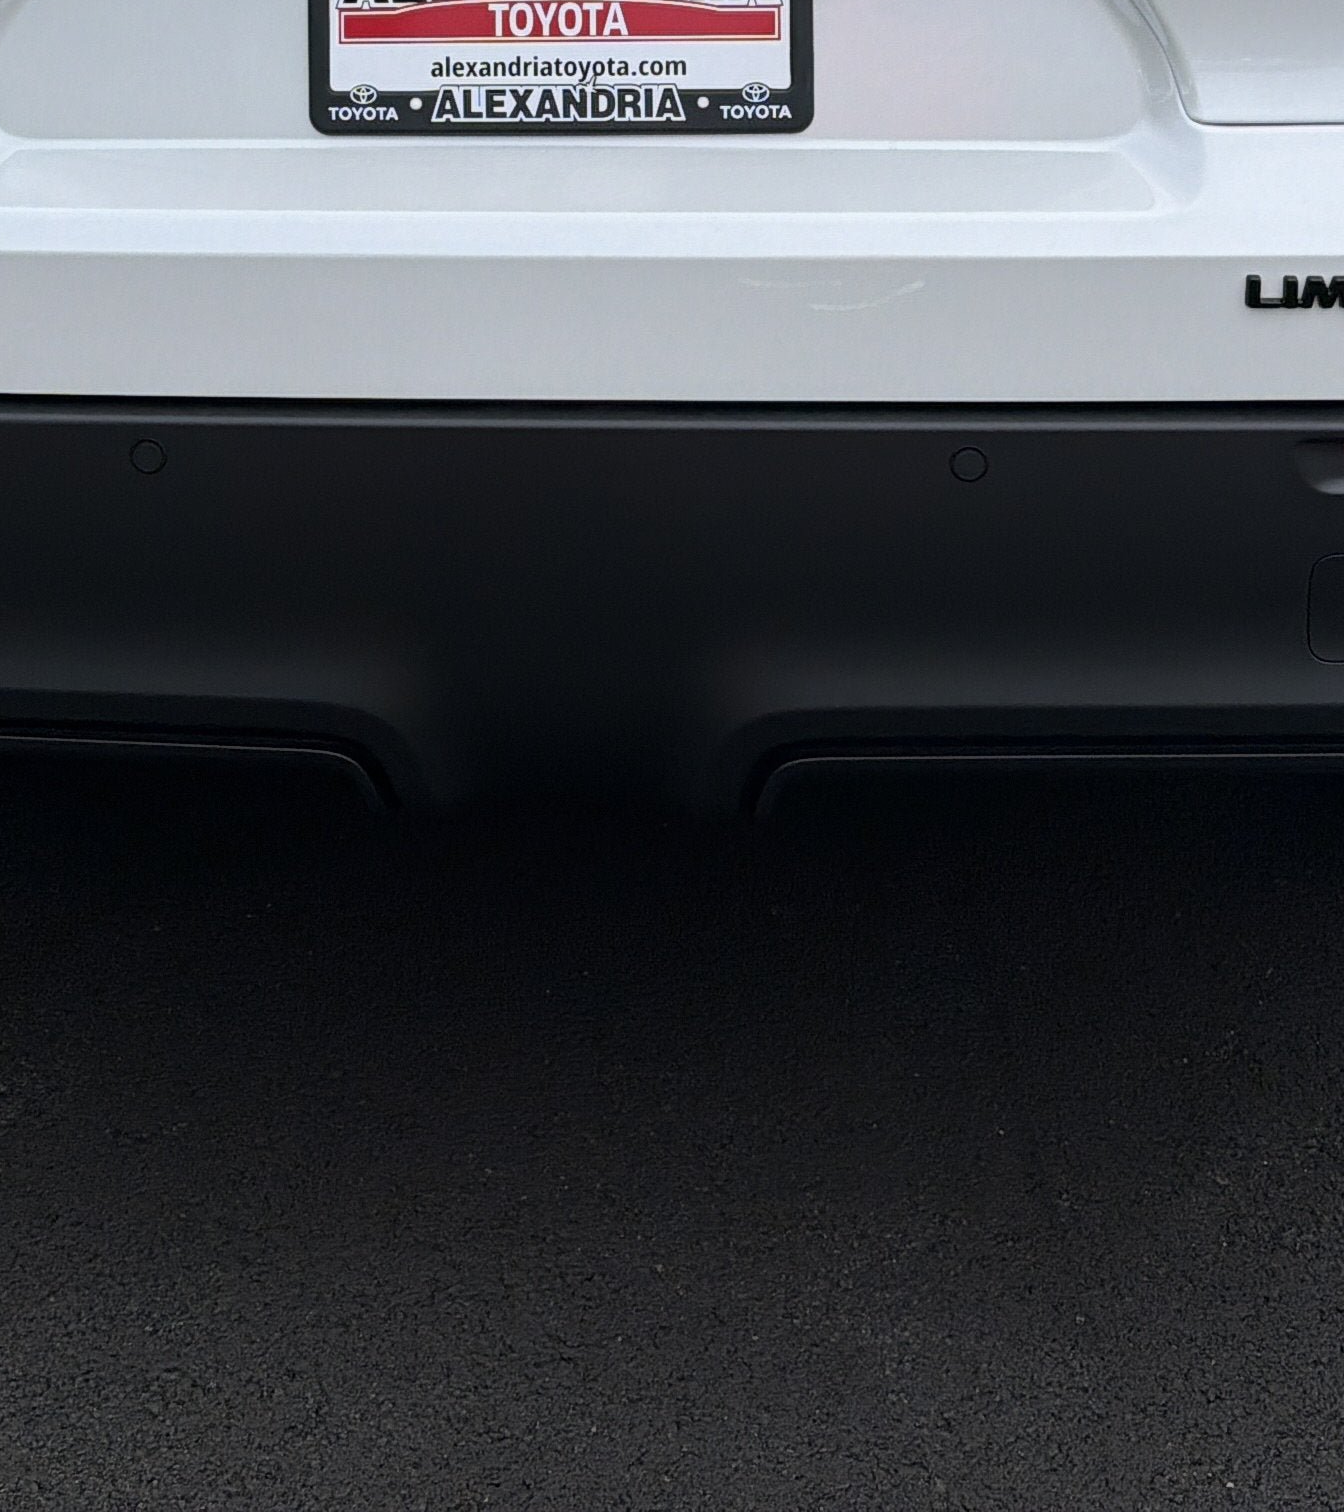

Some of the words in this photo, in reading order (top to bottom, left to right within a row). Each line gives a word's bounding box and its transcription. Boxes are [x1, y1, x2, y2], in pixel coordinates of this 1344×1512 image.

[488, 2, 629, 37] TOYOTA
[430, 55, 687, 83] alexandriatoyota.com
[328, 105, 399, 122] TOYOTA
[430, 85, 686, 122] ALEXANDRIA
[719, 102, 792, 120] TOYOTA
